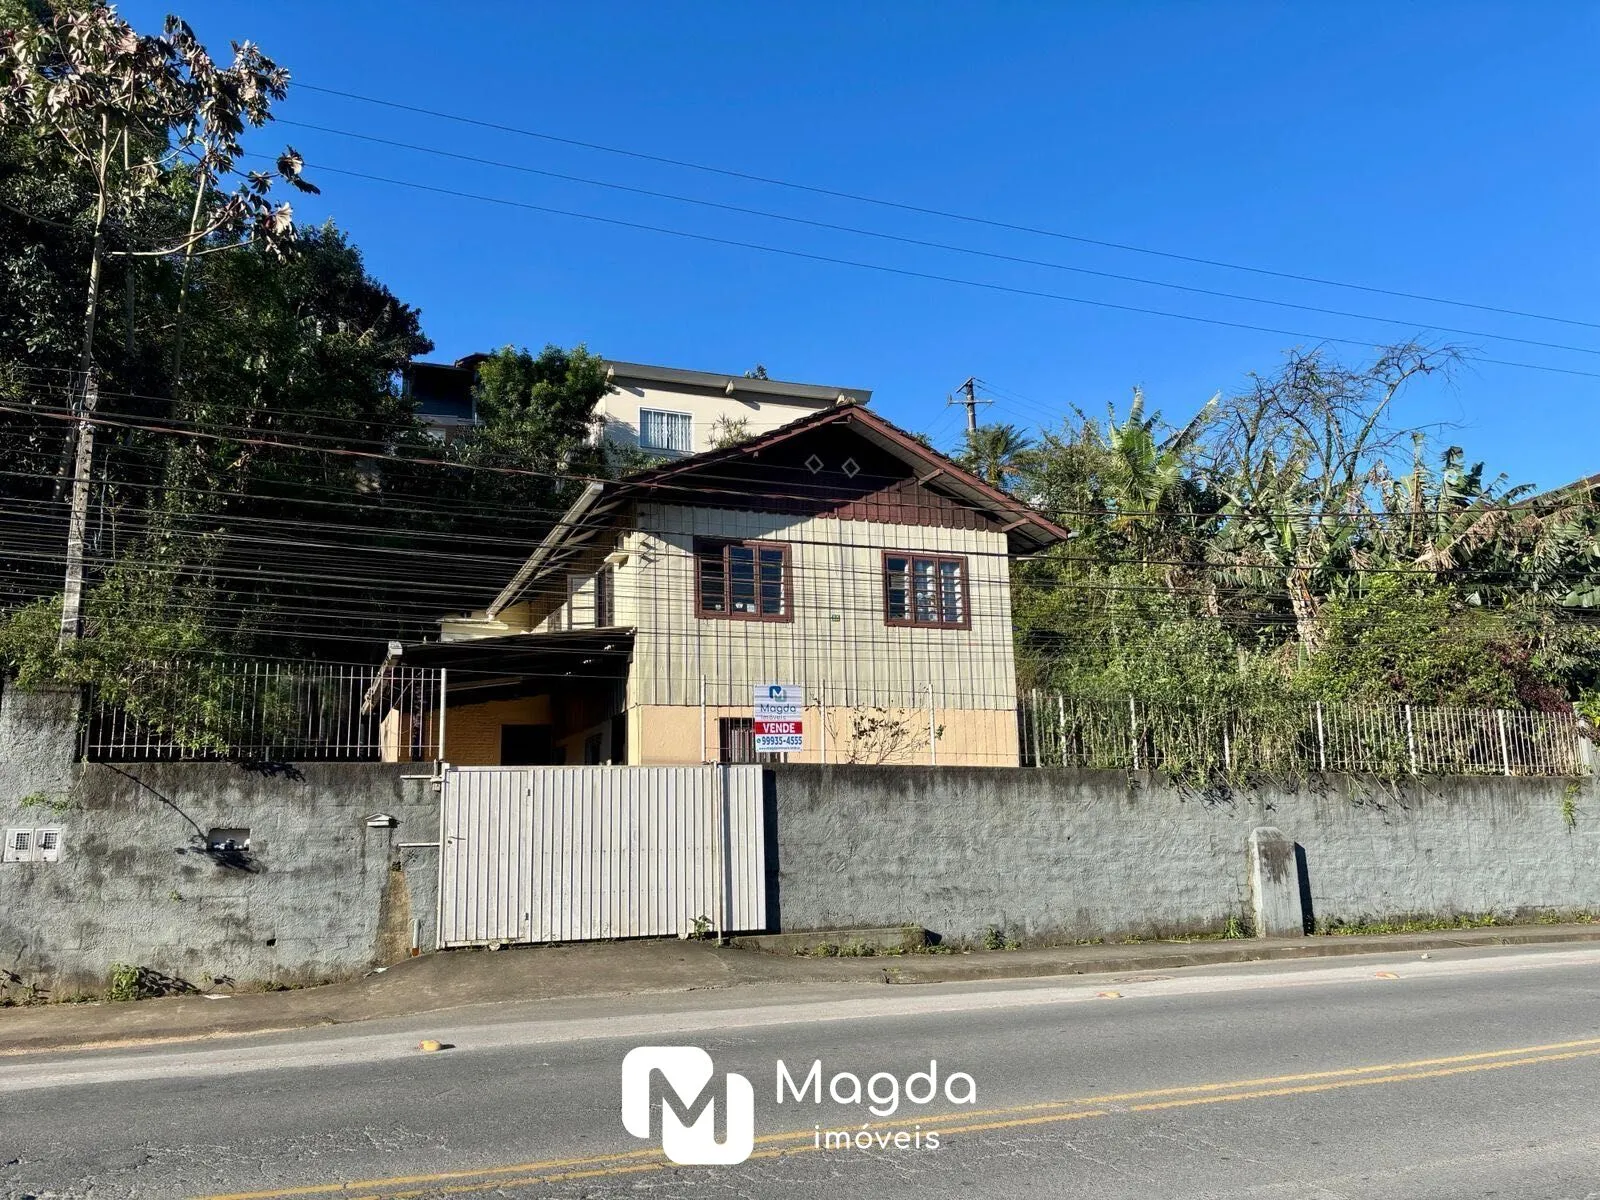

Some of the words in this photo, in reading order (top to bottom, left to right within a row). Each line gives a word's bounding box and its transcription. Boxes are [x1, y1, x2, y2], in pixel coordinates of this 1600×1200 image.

[760, 703, 797, 714] Magda
[762, 722, 796, 734] VENDE
[761, 736, 803, 745] 99935-4555
